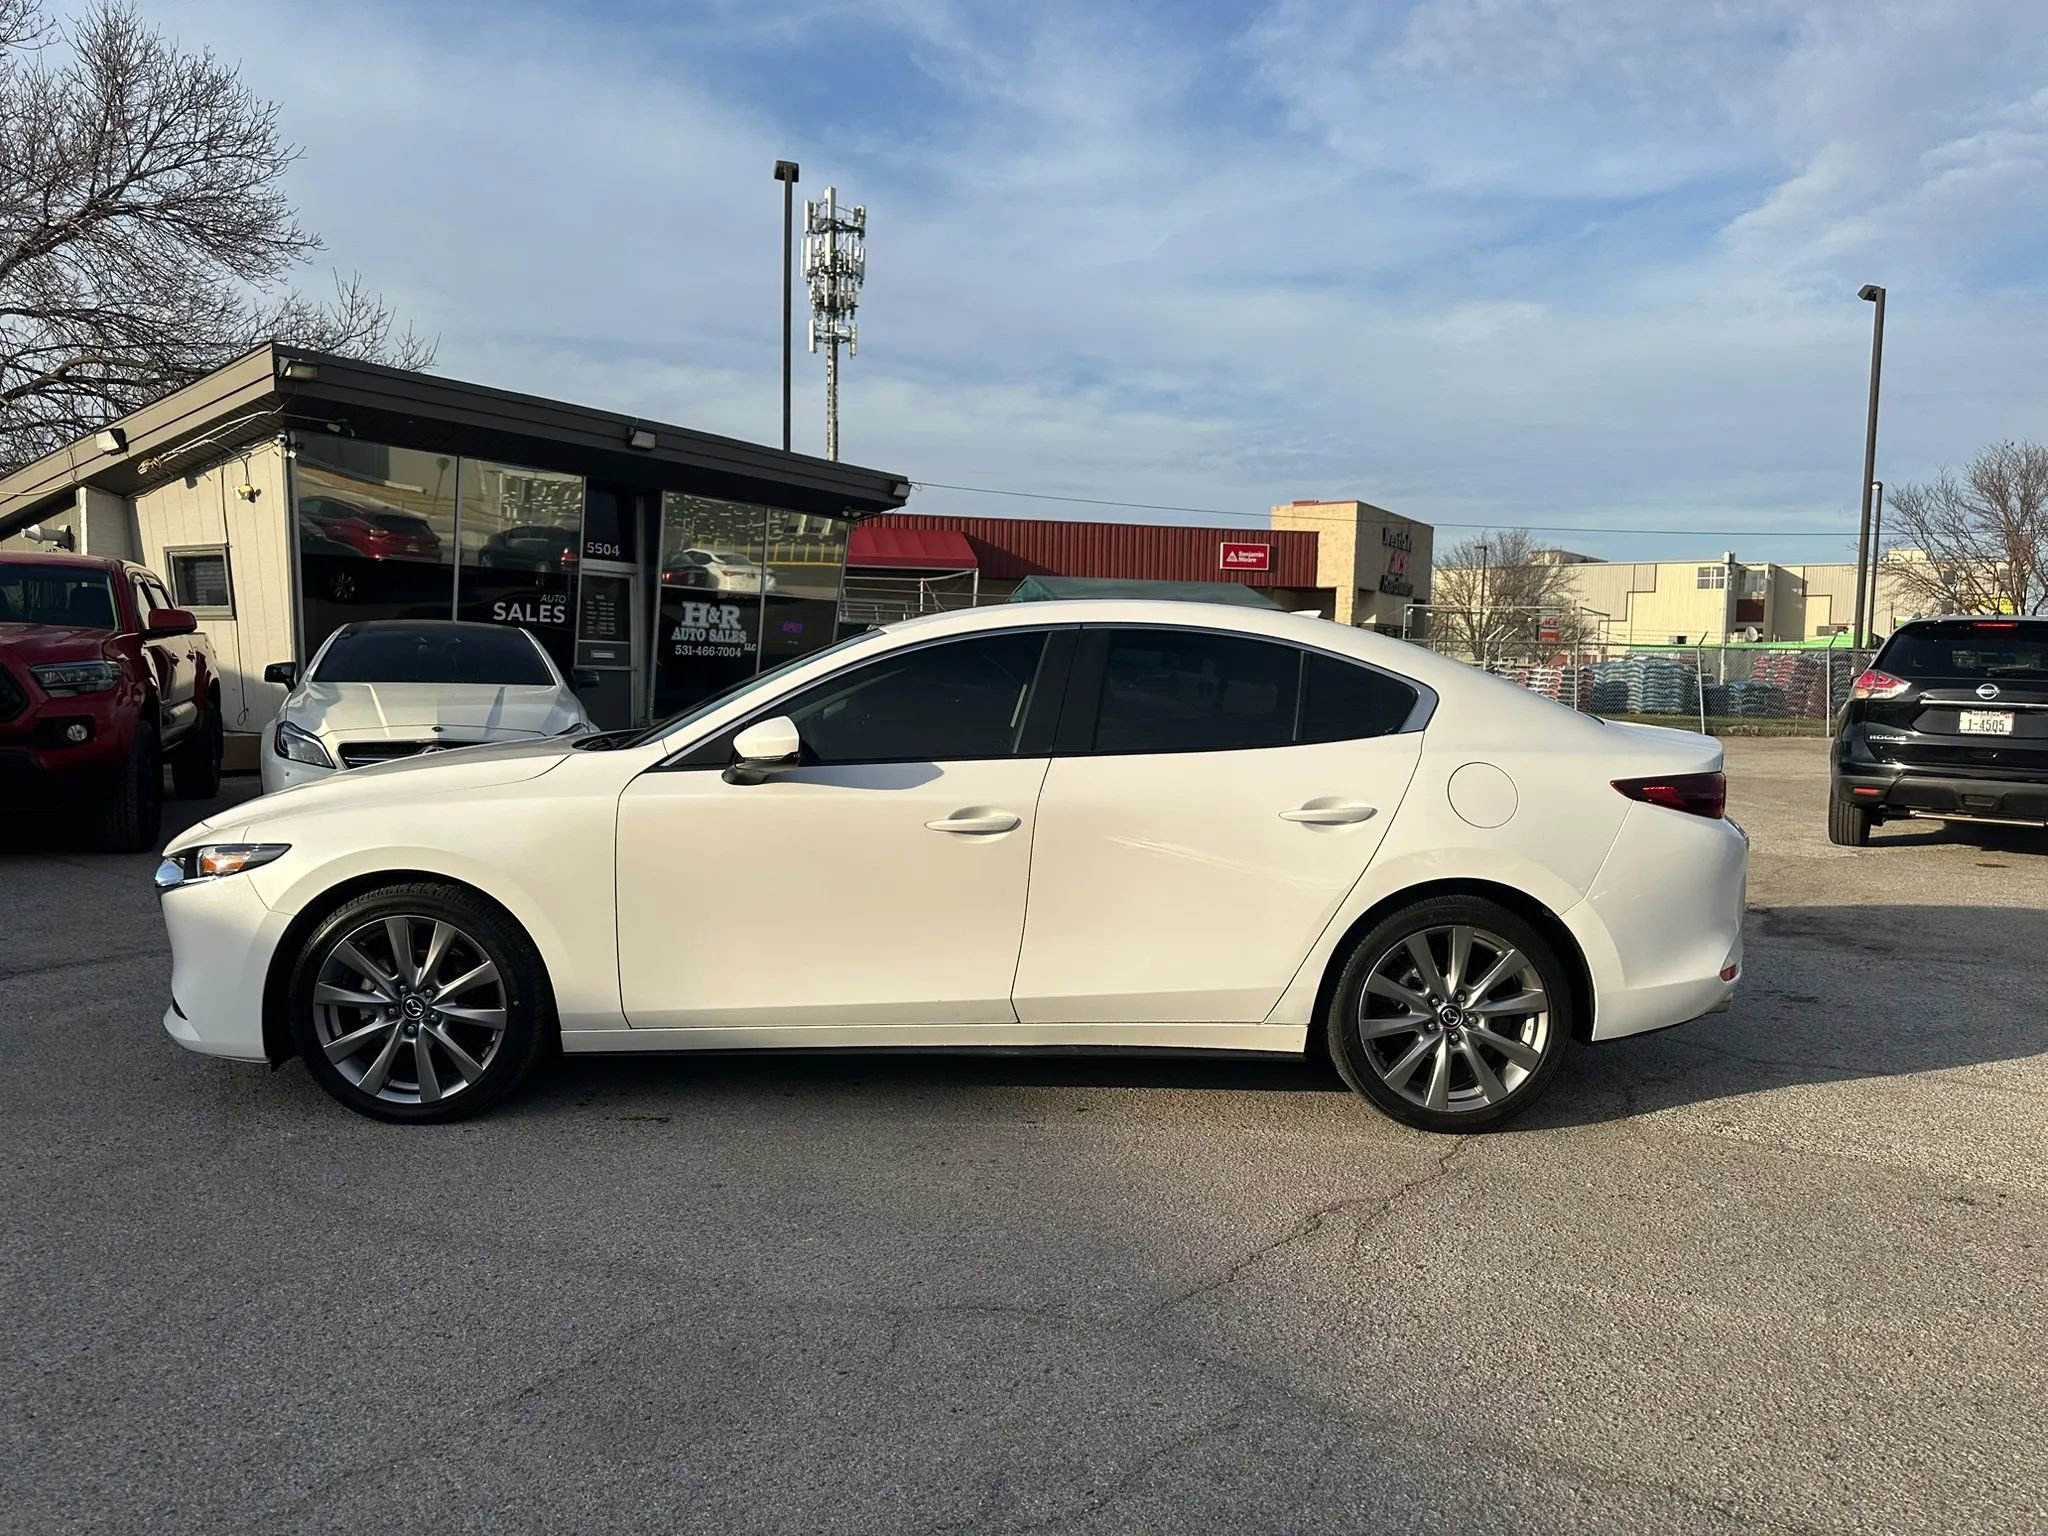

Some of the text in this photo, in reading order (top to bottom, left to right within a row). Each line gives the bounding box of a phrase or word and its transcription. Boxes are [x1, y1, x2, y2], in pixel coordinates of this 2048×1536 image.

[586, 541, 620, 557] 5504
[540, 593, 567, 604] AUTO
[493, 602, 566, 623] SALES
[681, 601, 742, 630] H&R
[671, 627, 748, 643] AUTO SALES
[674, 645, 742, 658] 531-466-7004
[743, 643, 757, 652] LLC
